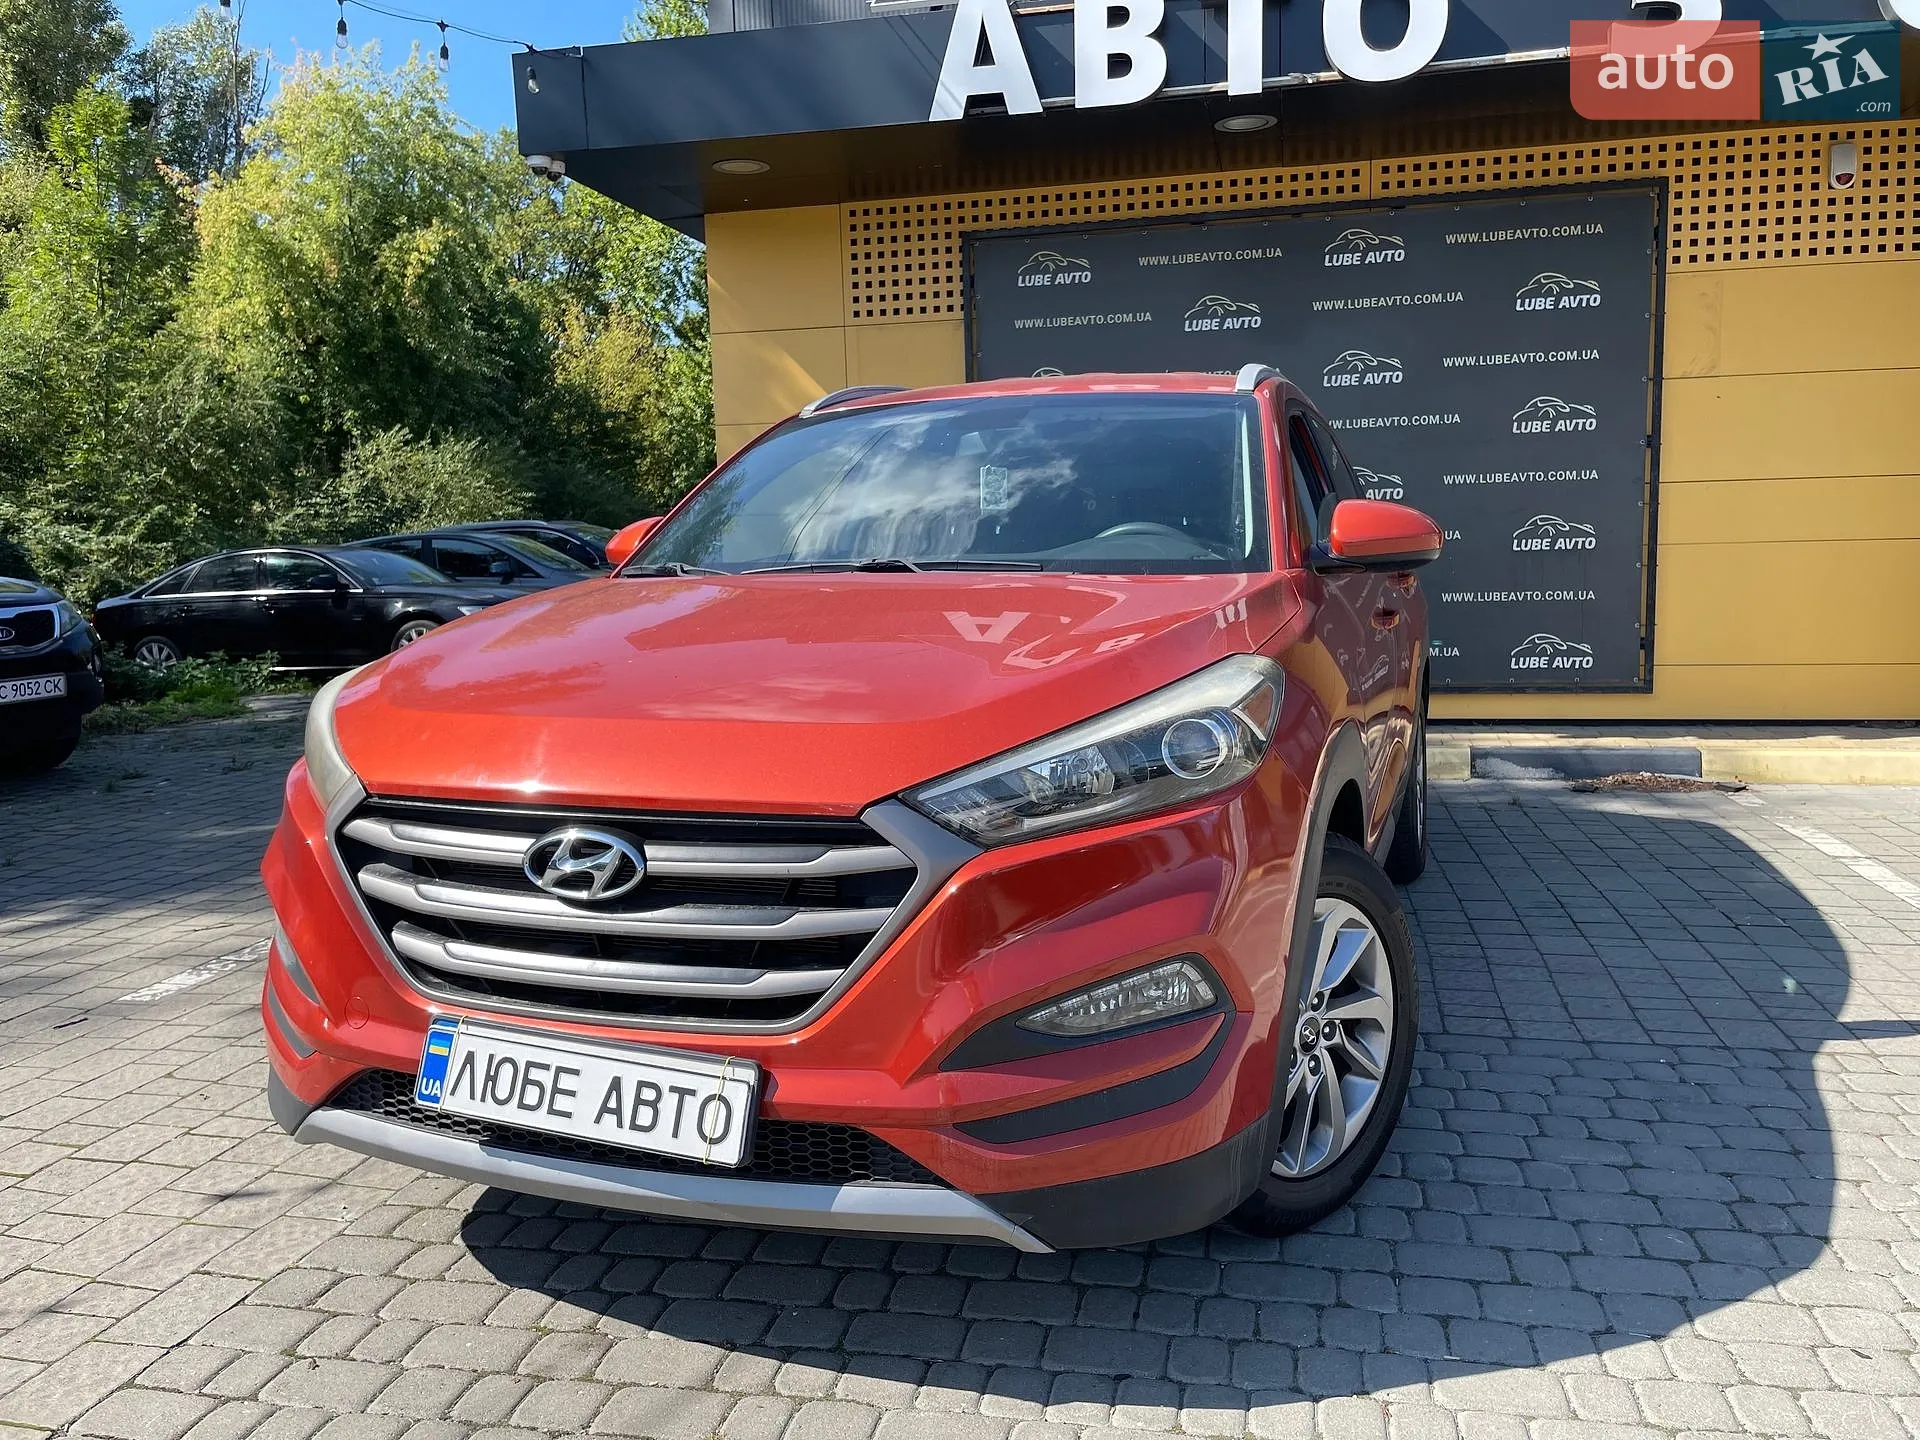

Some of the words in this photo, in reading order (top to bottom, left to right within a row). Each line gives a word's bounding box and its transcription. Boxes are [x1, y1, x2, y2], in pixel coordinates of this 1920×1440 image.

[1446, 224, 1603, 244] WWW.LUBEAVTO.COM.UA
[1139, 248, 1282, 265] WWW.LUBEAVTO.COM.UA
[1325, 253, 1362, 266] LUBE
[1365, 250, 1405, 263] AVTO
[1018, 274, 1051, 287] LUBE
[1055, 271, 1091, 284] AVTO
[1312, 292, 1463, 310] WWW.LUBEAVTO.COM.UA
[1516, 297, 1555, 310] LUBE
[1558, 294, 1600, 308] AVTO
[1015, 312, 1152, 328] WWW.LUBEAVTO.COM.UA
[1185, 319, 1220, 331] LUBE
[1223, 316, 1261, 329] AVTO
[1443, 350, 1599, 367] WWW.LUBEAVTO.COM.UA
[1323, 374, 1360, 386] LUBE
[1363, 371, 1402, 384] AVTO
[1513, 421, 1551, 433] LUBE
[1555, 418, 1596, 431] AVTO
[1444, 470, 1598, 484] WWW.LUBEAVTO.COM.UA
[1366, 488, 1403, 499] AVTO
[1513, 538, 1551, 550] LUBE
[1554, 537, 1596, 550] AVTO
[1442, 590, 1595, 602] WWW.LUBEAVTO.COM.UA
[1511, 657, 1549, 669] LUBE
[1552, 657, 1593, 668] AVTO
[11, 681, 42, 698] 9052
[44, 678, 63, 694] CK
[421, 1076, 442, 1099] UA
[449, 1049, 581, 1119] ЛЮБЕ
[594, 1075, 732, 1145] АВТО
